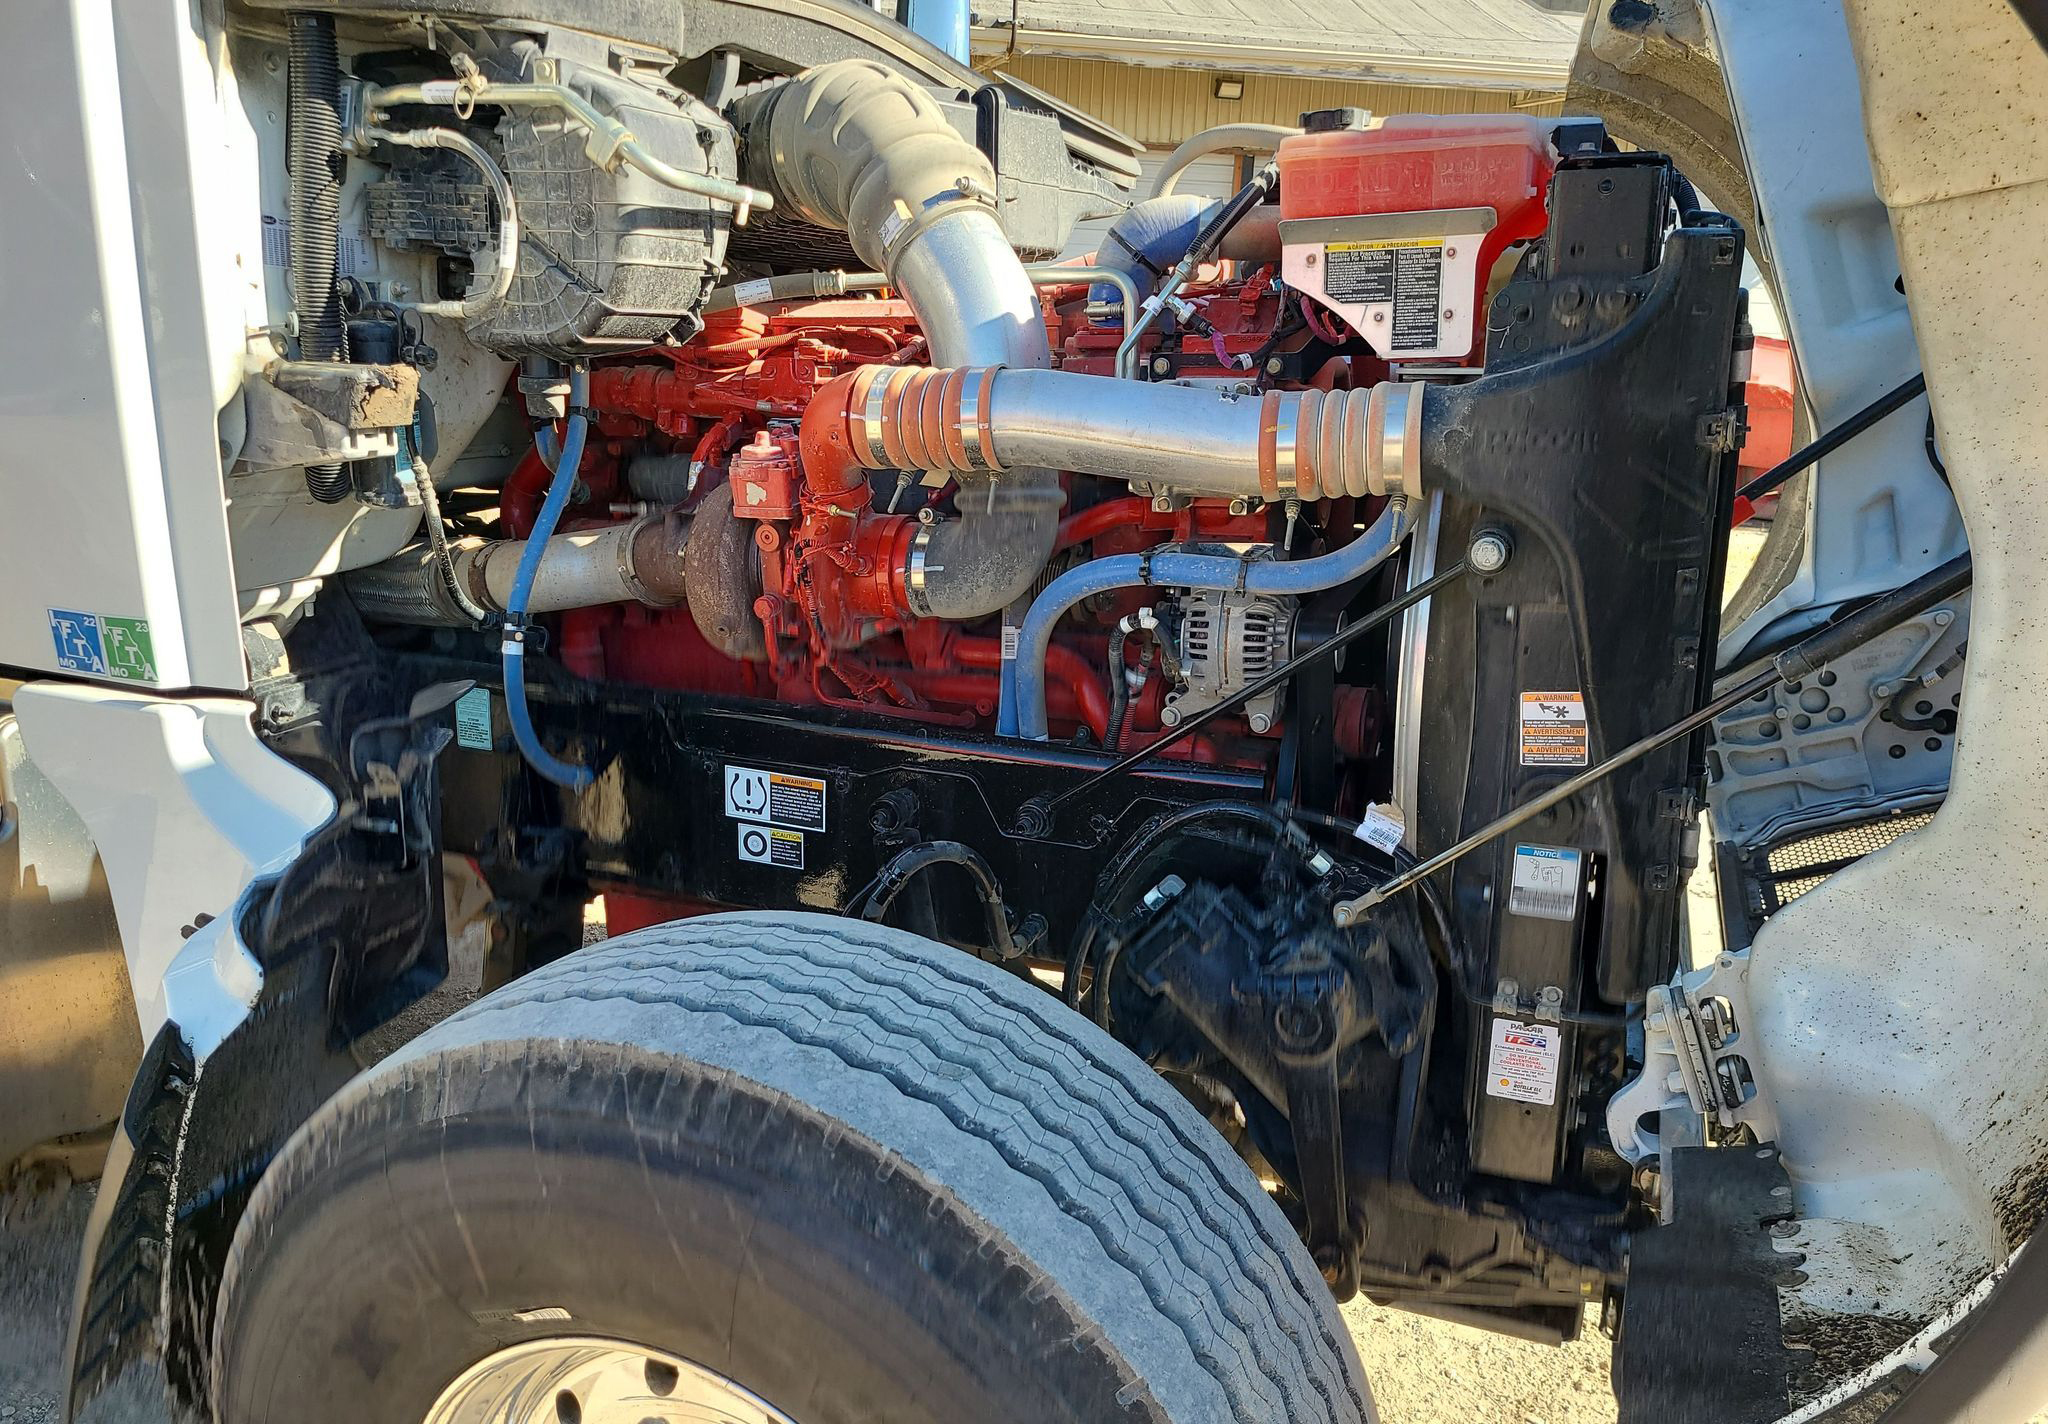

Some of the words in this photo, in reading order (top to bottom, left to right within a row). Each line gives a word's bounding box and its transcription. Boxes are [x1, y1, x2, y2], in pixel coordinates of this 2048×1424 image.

[84, 617, 96, 626] 22
[135, 623, 149, 632] 23
[60, 658, 77, 668] MO
[110, 667, 128, 677] MO
[785, 778, 812, 787] WARNING
[1505, 1035, 1547, 1048] TRP
[1506, 1056, 1542, 1066] CONVENTIONAL
